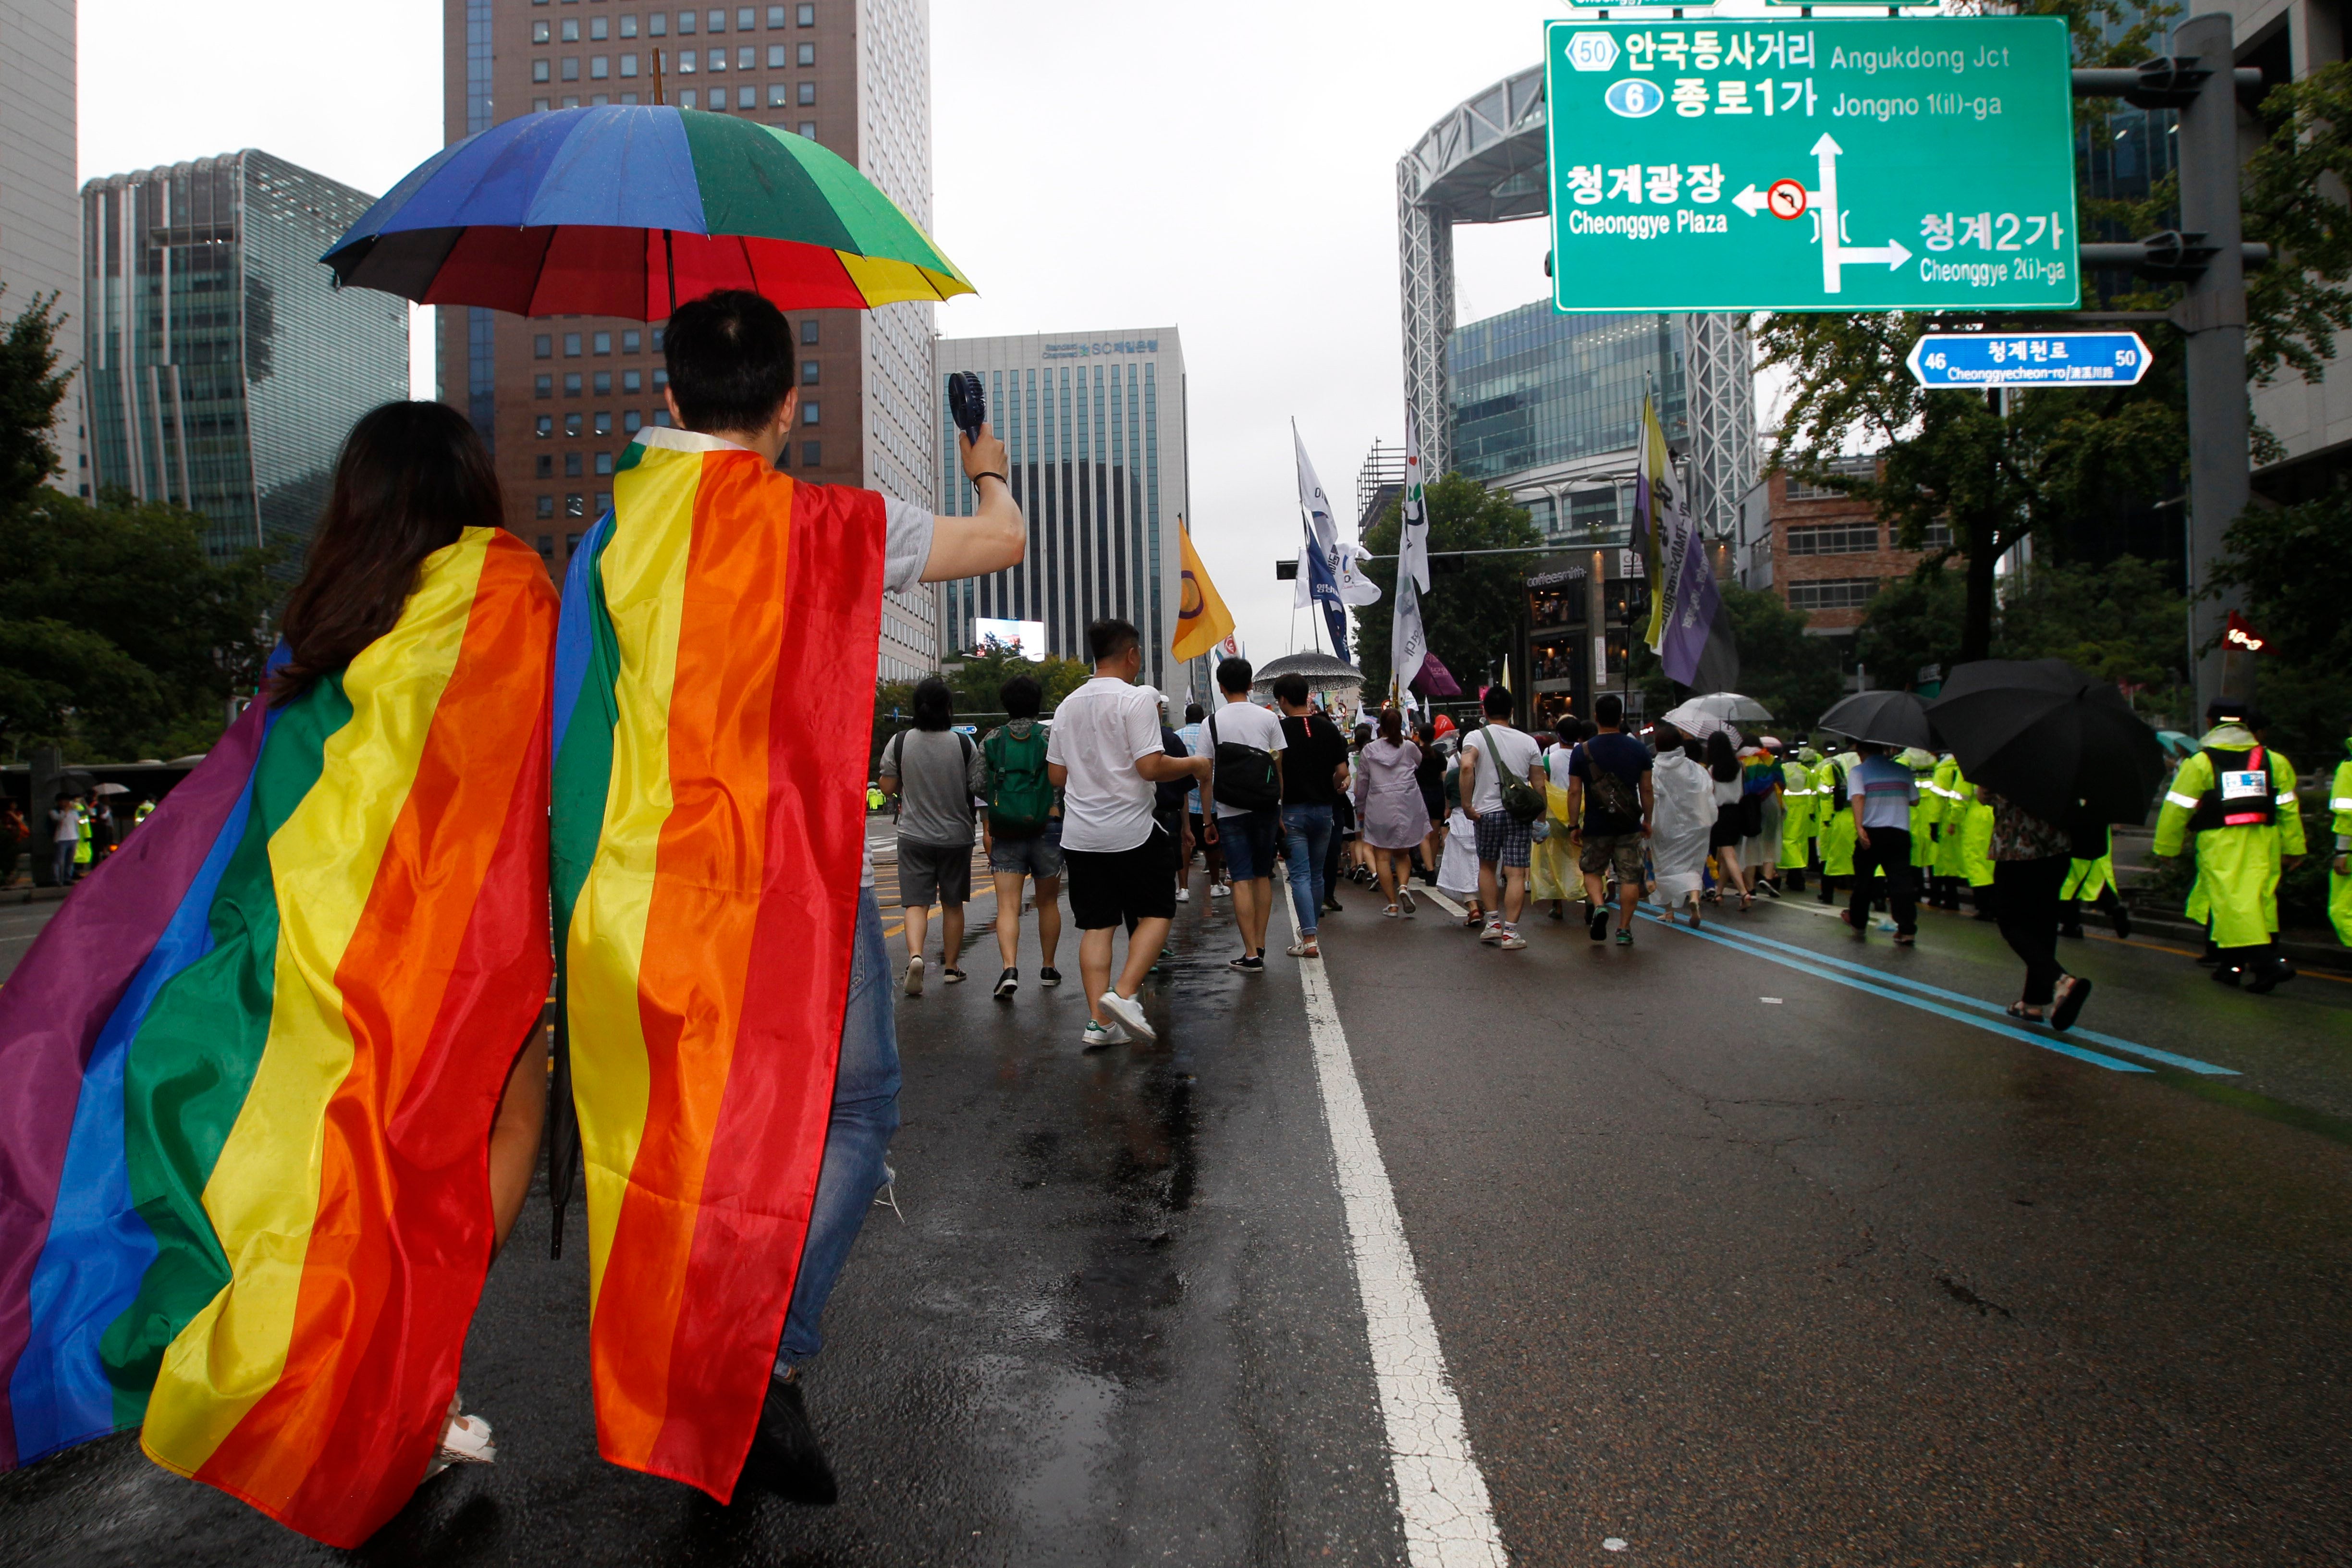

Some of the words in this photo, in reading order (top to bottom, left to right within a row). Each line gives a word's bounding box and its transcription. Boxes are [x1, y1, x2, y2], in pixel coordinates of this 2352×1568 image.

[1580, 40, 1606, 62] 50
[1625, 30, 1815, 71] 안국동사거리
[1831, 46, 1964, 74] Angukdong
[1973, 46, 2009, 67] Jct
[1625, 83, 1645, 112] 6
[1671, 77, 1818, 118] 종로1가
[1832, 93, 1919, 122] Jongno
[1926, 93, 2002, 121] 1(il)-ga
[1567, 163, 1725, 205] 청계광장
[1569, 209, 1670, 240] Cheonggye
[1677, 209, 1728, 233] Plaza
[1920, 211, 2064, 251] 청계2가
[1920, 257, 2008, 287] Cheonggye
[2013, 257, 2066, 286] 2(i)-ga
[1924, 353, 1947, 370] 46
[1988, 341, 2069, 363] 청계천로
[2115, 350, 2137, 367] 50
